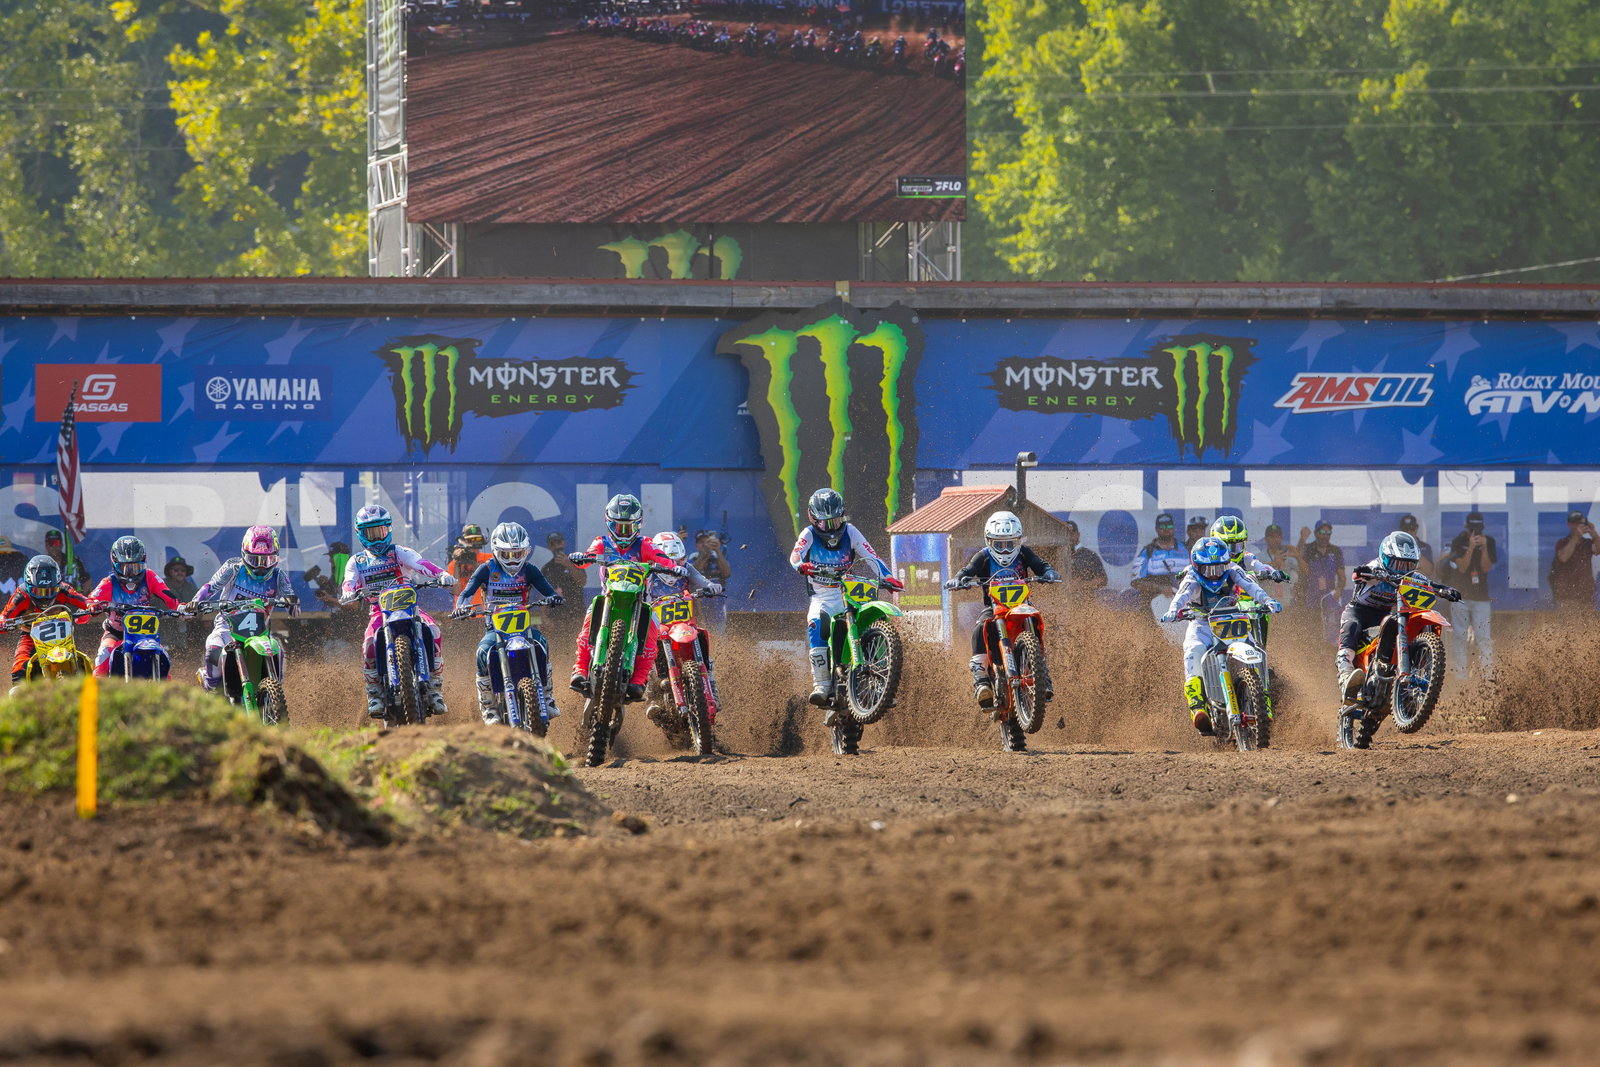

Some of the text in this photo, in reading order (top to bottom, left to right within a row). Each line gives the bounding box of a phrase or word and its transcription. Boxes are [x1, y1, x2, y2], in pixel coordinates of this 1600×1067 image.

[468, 362, 621, 390] MONSTER
[1005, 362, 1163, 391] MONSTER
[232, 378, 321, 401] YAMAHA
[490, 394, 594, 404] ENERGY
[1281, 375, 1431, 411] AMSOIL
[1028, 396, 1135, 406] ENERGY
[133, 482, 673, 588] RANCH
[610, 567, 644, 586] 35
[850, 583, 878, 602] 44
[998, 586, 1023, 602] 17
[1403, 589, 1435, 608] 47
[238, 613, 258, 631] 4
[497, 612, 526, 632] 71
[661, 602, 689, 624] 65
[39, 622, 66, 642] 21
[128, 616, 156, 633] 94
[1216, 620, 1247, 639] 70
